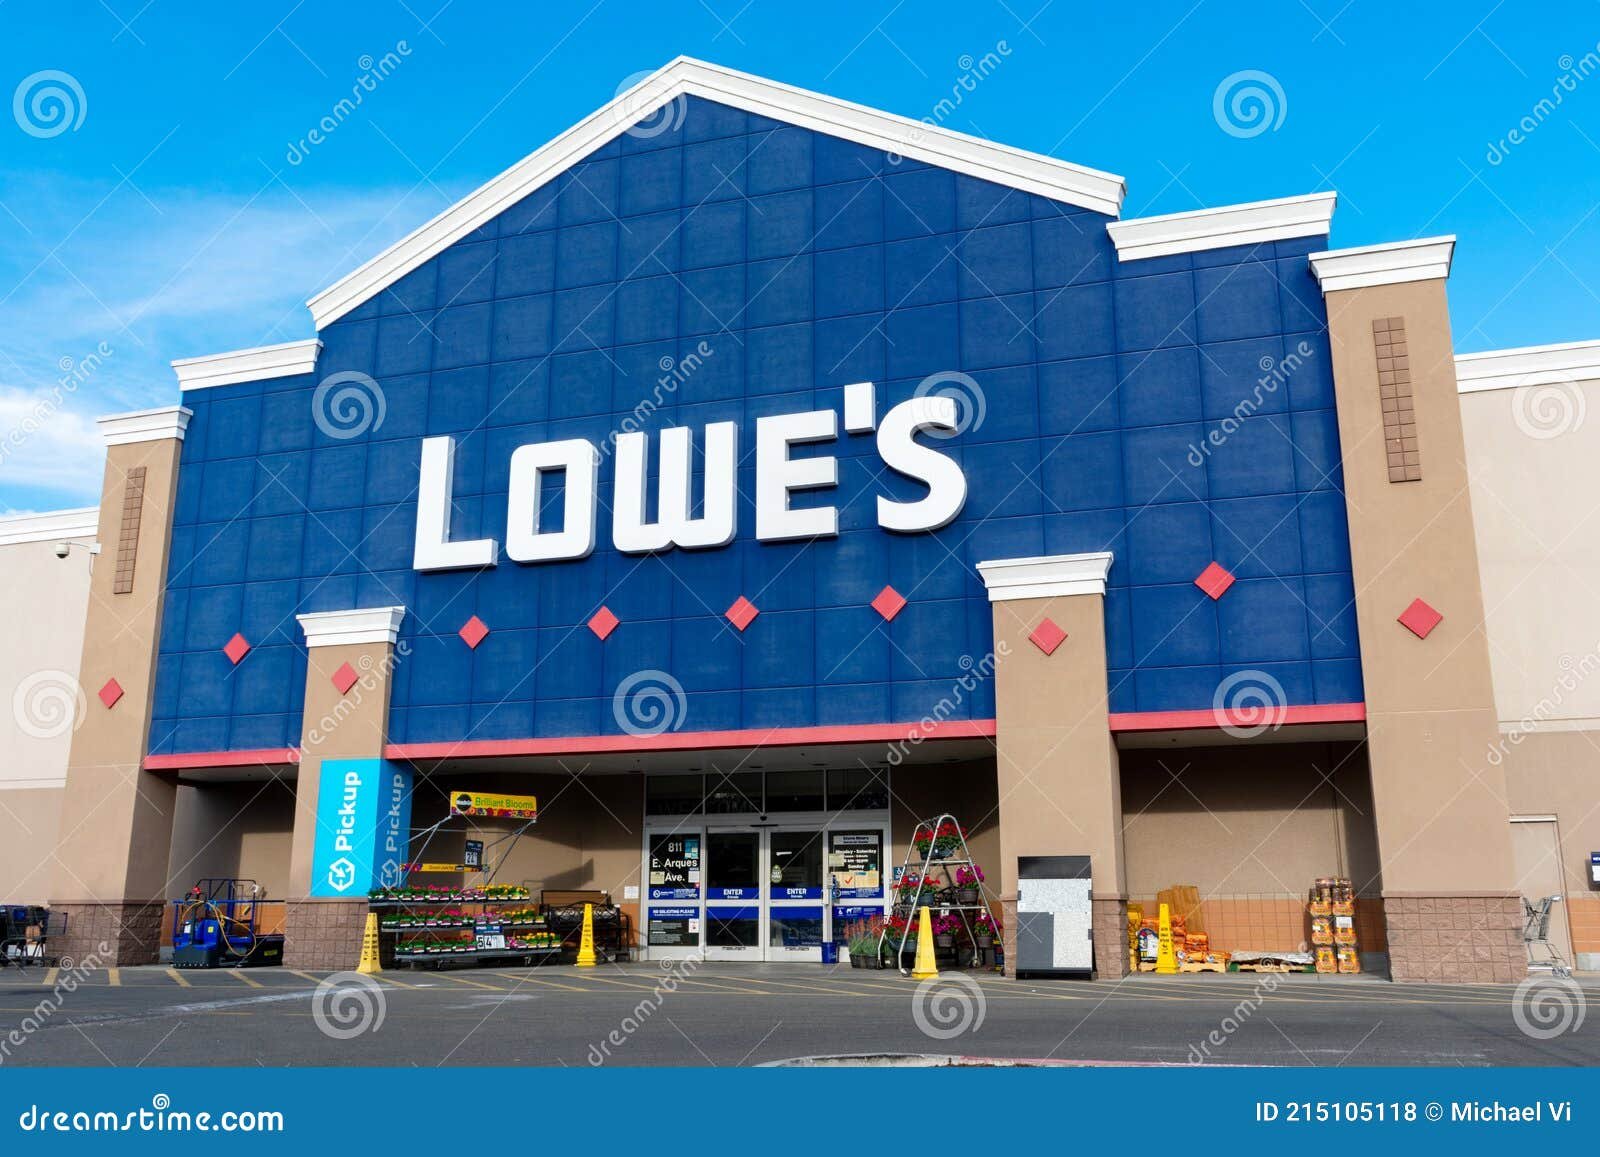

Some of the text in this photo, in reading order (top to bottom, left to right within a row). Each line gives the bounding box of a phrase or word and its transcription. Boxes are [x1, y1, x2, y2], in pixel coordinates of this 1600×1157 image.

[413, 381, 968, 572] LOWE'S
[475, 797, 504, 807] Brilliant
[505, 799, 534, 809] Blooms
[335, 771, 362, 852] Pickup
[385, 774, 405, 852] Pickup
[668, 842, 683, 853] 811
[652, 858, 698, 869] E. Arques
[665, 872, 686, 882] Ave.
[723, 888, 743, 896] ENTER
[786, 887, 807, 895] ENTER
